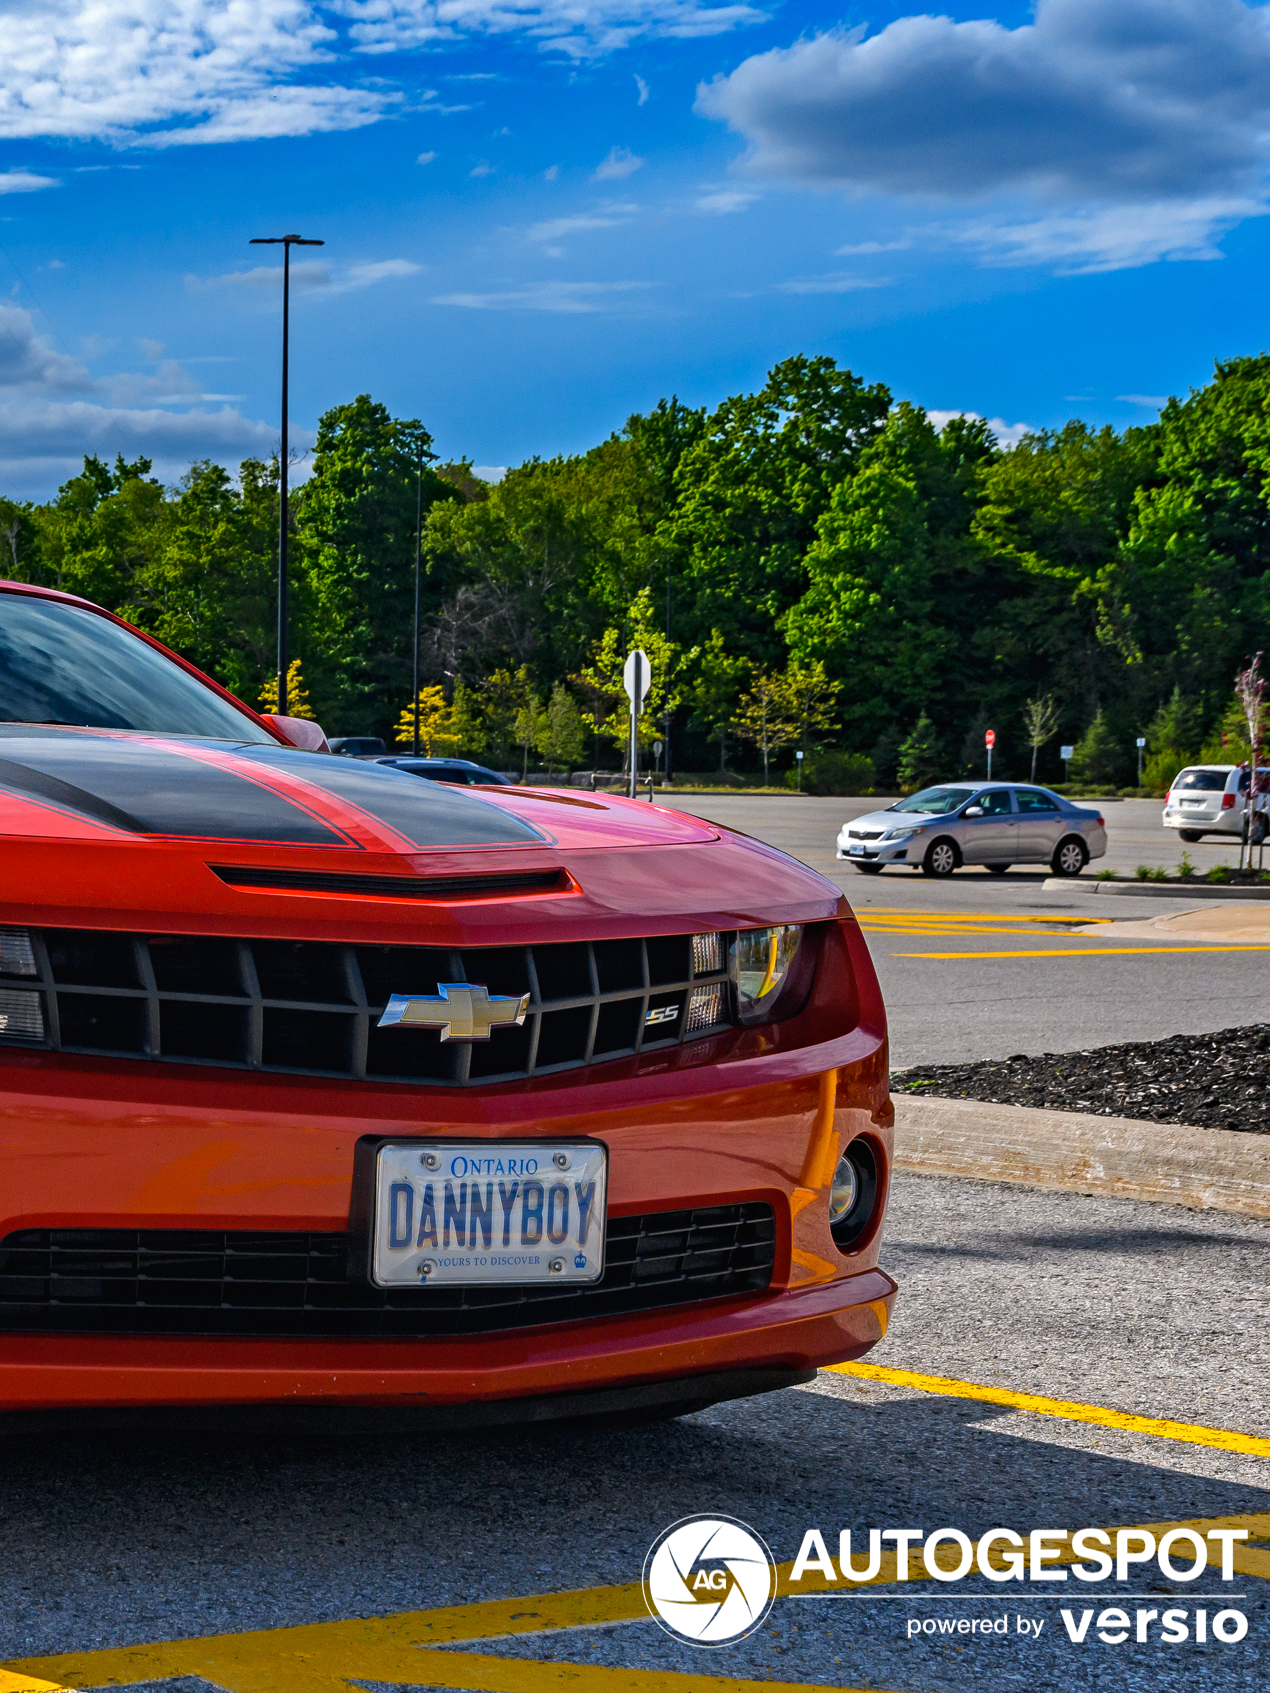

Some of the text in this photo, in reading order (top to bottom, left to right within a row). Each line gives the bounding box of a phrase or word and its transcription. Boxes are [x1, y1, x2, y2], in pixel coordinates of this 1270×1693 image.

[645, 1004, 679, 1025] SS
[450, 1156, 538, 1178] ONTARIO
[388, 1181, 596, 1249] DANNYBOY
[438, 1255, 540, 1267] YOURS TO DISCOVER
